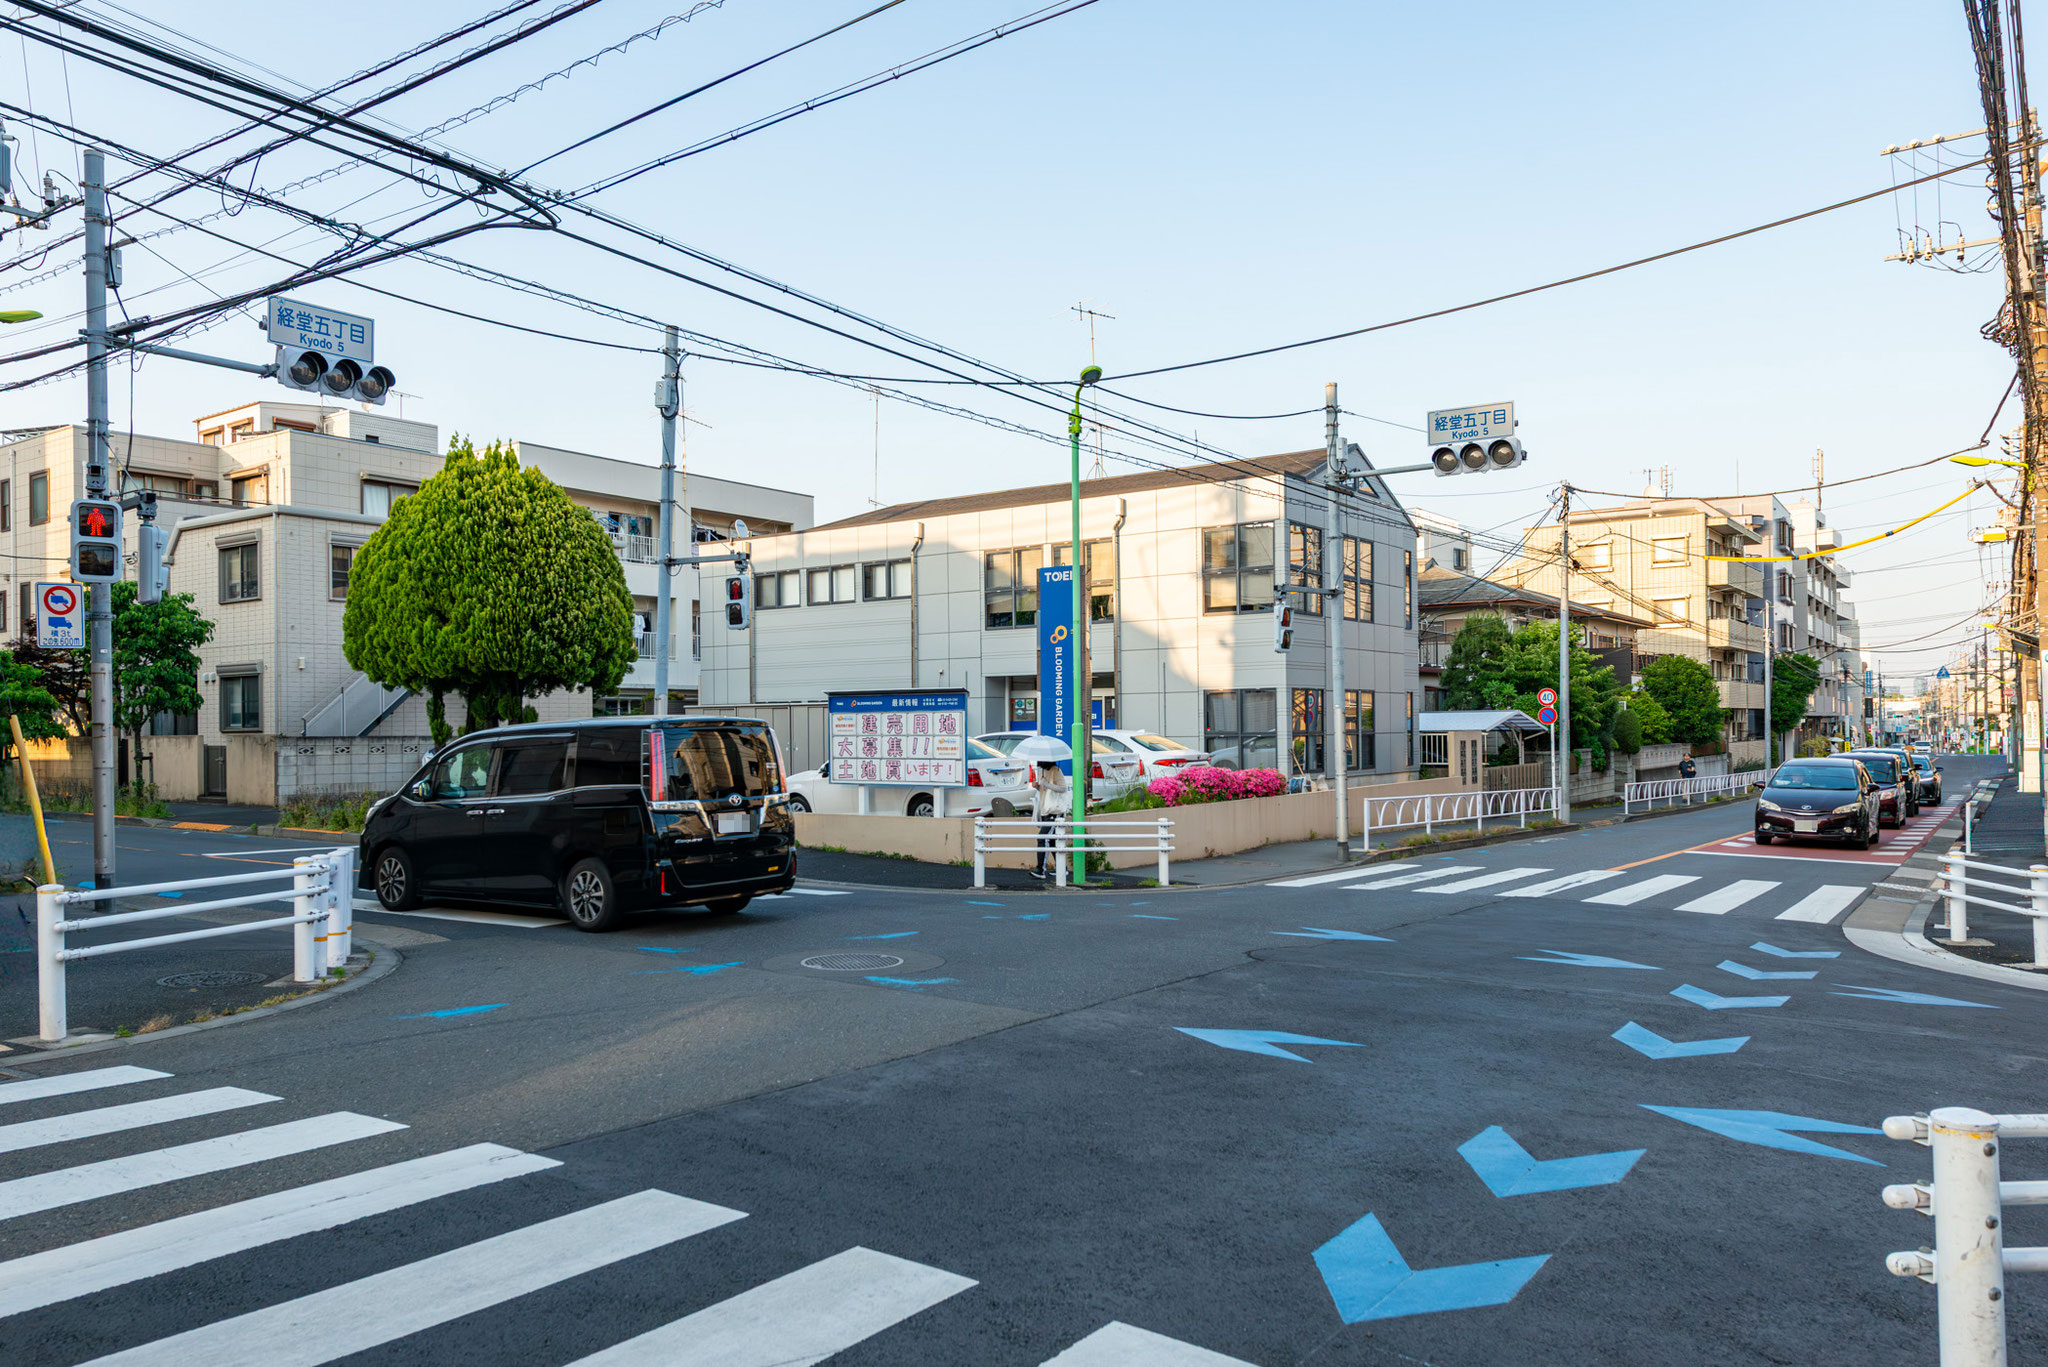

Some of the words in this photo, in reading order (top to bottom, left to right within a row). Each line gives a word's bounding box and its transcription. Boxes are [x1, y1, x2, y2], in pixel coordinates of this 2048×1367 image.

[277, 306, 365, 344] 経堂五丁目
[300, 333, 333, 350] Kyodo
[337, 342, 345, 352] 5
[1434, 409, 1506, 432] 経堂五丁目
[1452, 429, 1479, 440] Kyodo
[1483, 427, 1489, 436] 5
[1055, 646, 1063, 696] BLOOMING
[1541, 692, 1553, 702] 40
[861, 713, 957, 734] 建売用地
[1055, 698, 1063, 737] GARDEN
